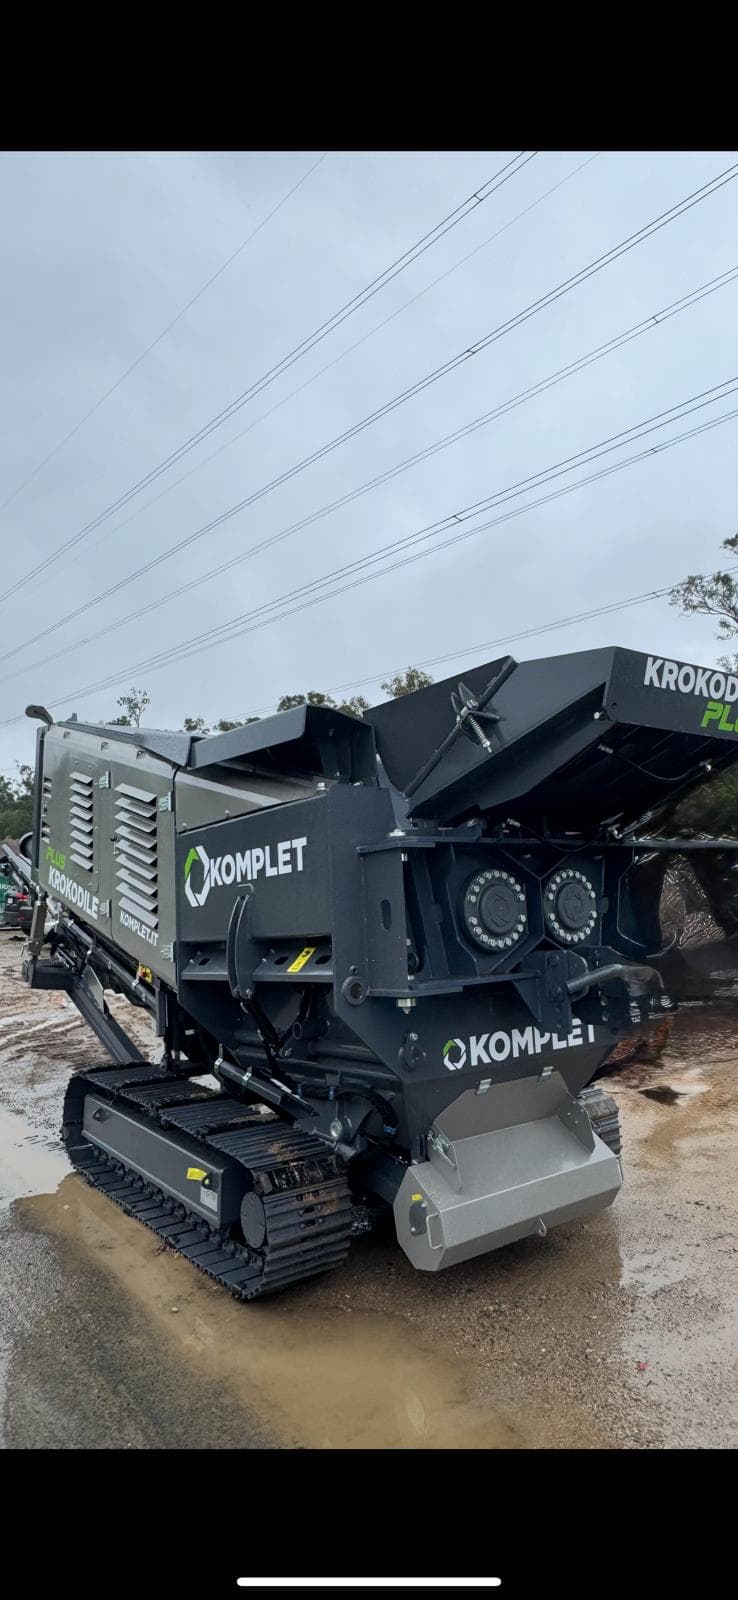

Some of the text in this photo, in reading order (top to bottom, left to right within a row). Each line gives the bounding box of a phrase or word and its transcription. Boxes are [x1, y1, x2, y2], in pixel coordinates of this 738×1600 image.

[701, 701, 738, 733] PL
[46, 846, 66, 870] PLUS
[210, 836, 308, 887] KOMPLET
[48, 865, 100, 921] KROKODILE
[120, 910, 159, 947] KOMPLET.IT
